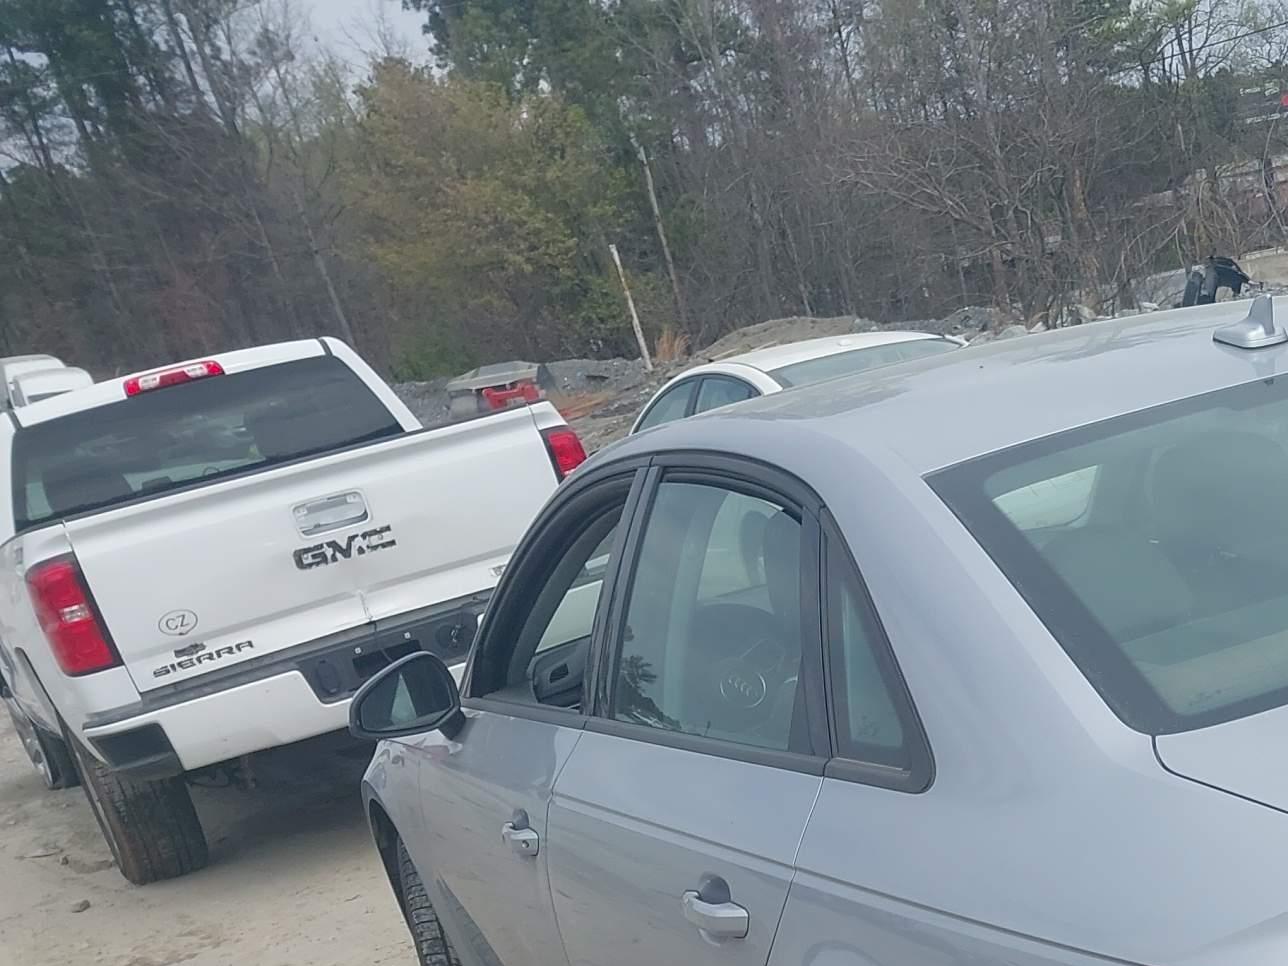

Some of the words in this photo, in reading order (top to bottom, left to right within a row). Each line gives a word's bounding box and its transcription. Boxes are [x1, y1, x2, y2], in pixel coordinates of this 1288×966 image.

[293, 524, 397, 570] GMC
[165, 614, 190, 631] CZ
[153, 640, 254, 678] SIERRA
